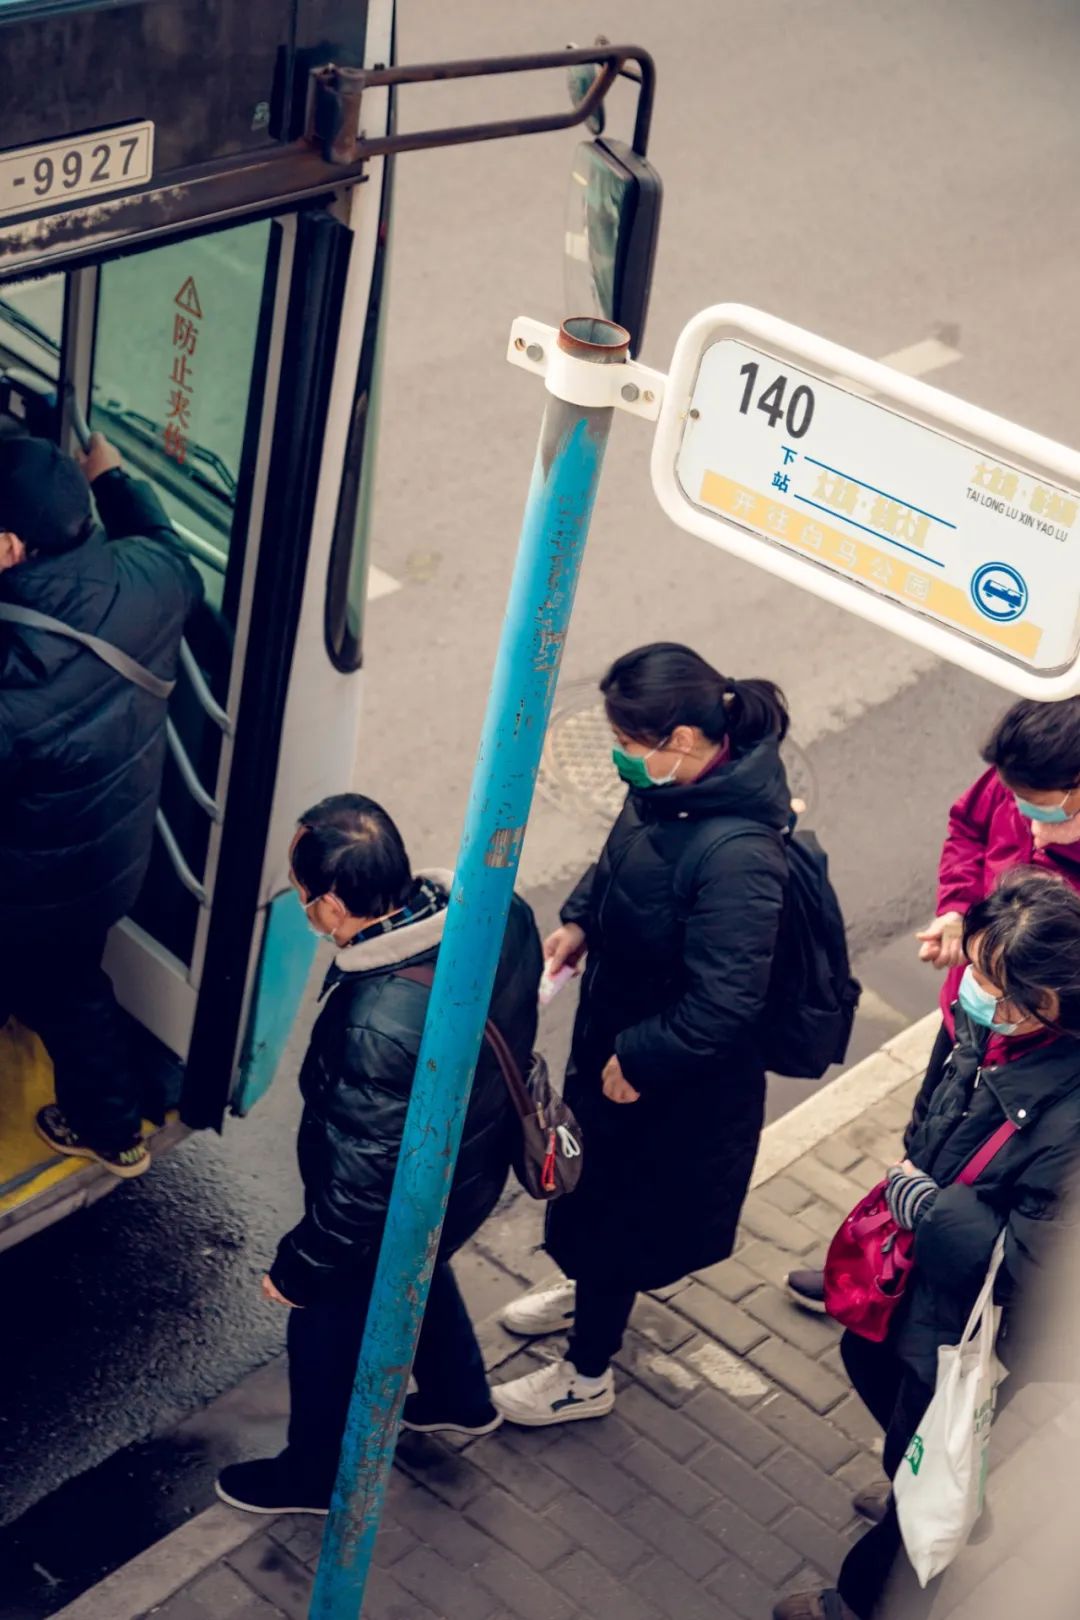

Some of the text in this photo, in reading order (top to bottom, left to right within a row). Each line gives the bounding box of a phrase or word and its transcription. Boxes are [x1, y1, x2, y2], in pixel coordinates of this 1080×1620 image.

[737, 361, 816, 440] 140
[735, 490, 930, 599] 开往白马公园
[965, 487, 1068, 543] TAI LONG LU XIN YAO LU
